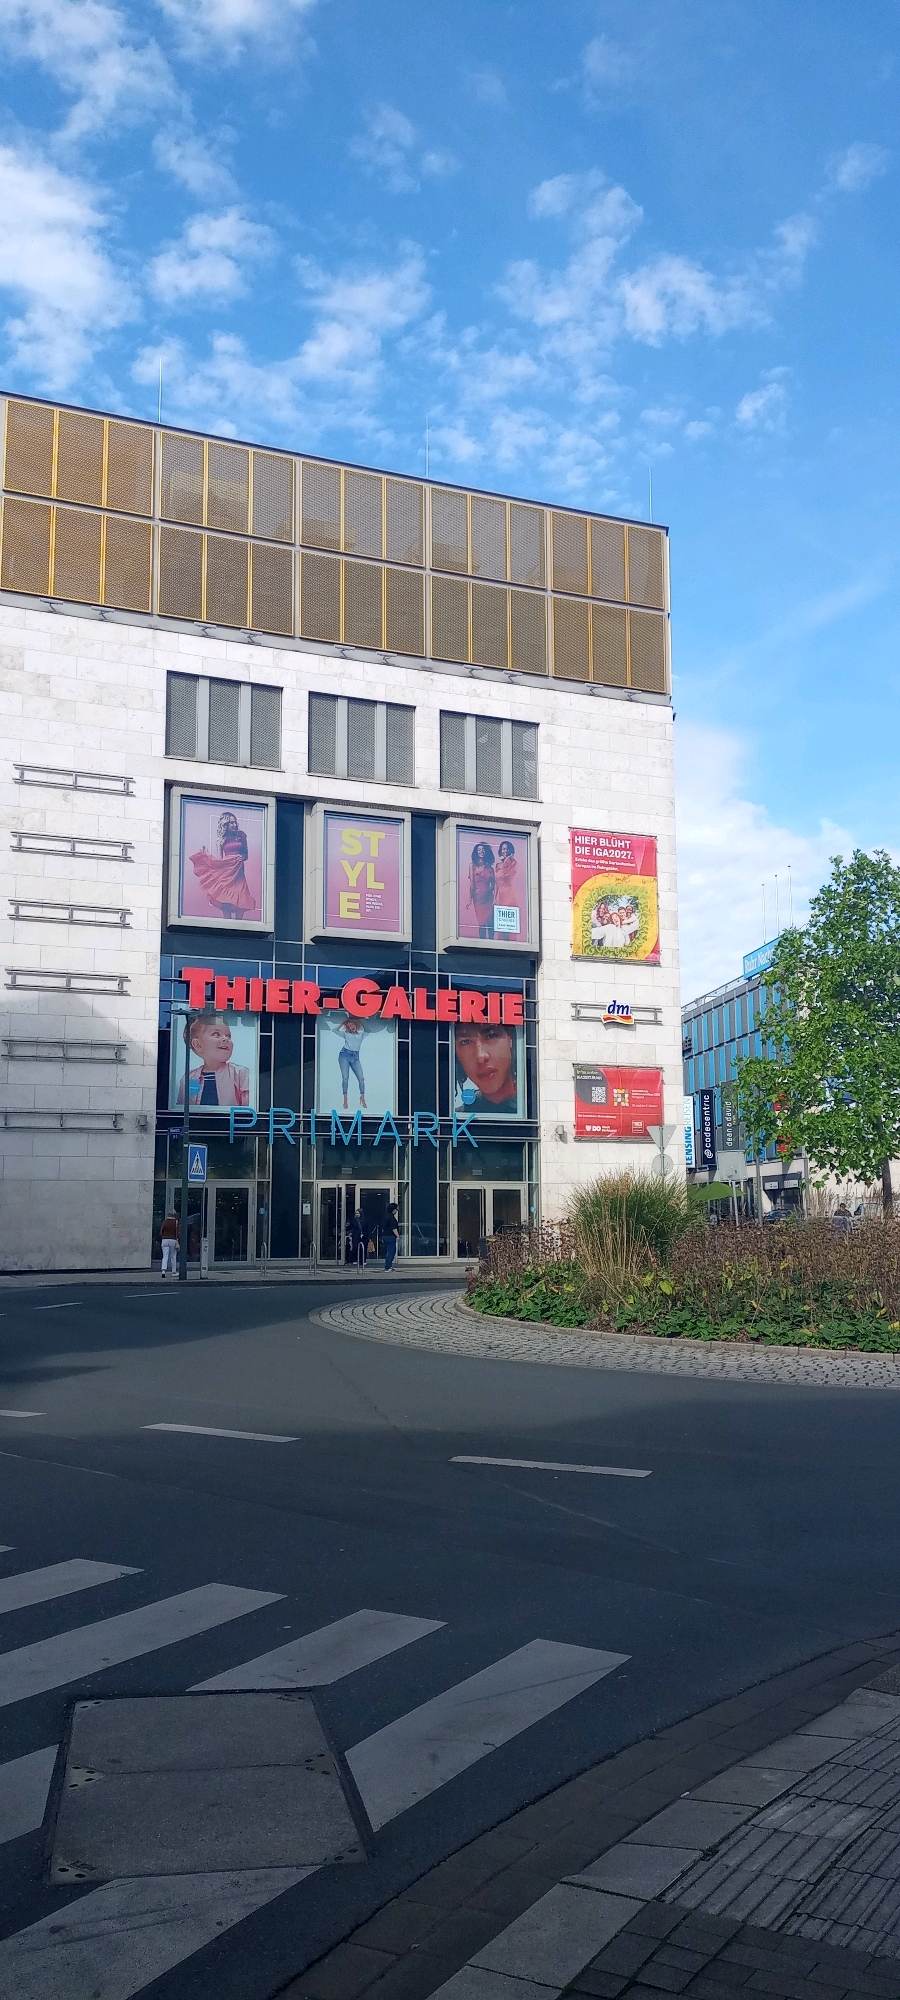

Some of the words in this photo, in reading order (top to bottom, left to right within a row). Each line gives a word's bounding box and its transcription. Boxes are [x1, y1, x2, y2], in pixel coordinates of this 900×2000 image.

[574, 835, 598, 846] HIER
[600, 836, 631, 849] BLÜHT
[574, 846, 591, 856] DIE
[592, 848, 634, 860] IGA2027.
[498, 910, 516, 919] THIER
[182, 967, 524, 1026] THIER-GALERIE
[607, 1000, 630, 1015] dm
[229, 1106, 479, 1148] PRIMARK
[702, 1094, 712, 1148] codecentric
